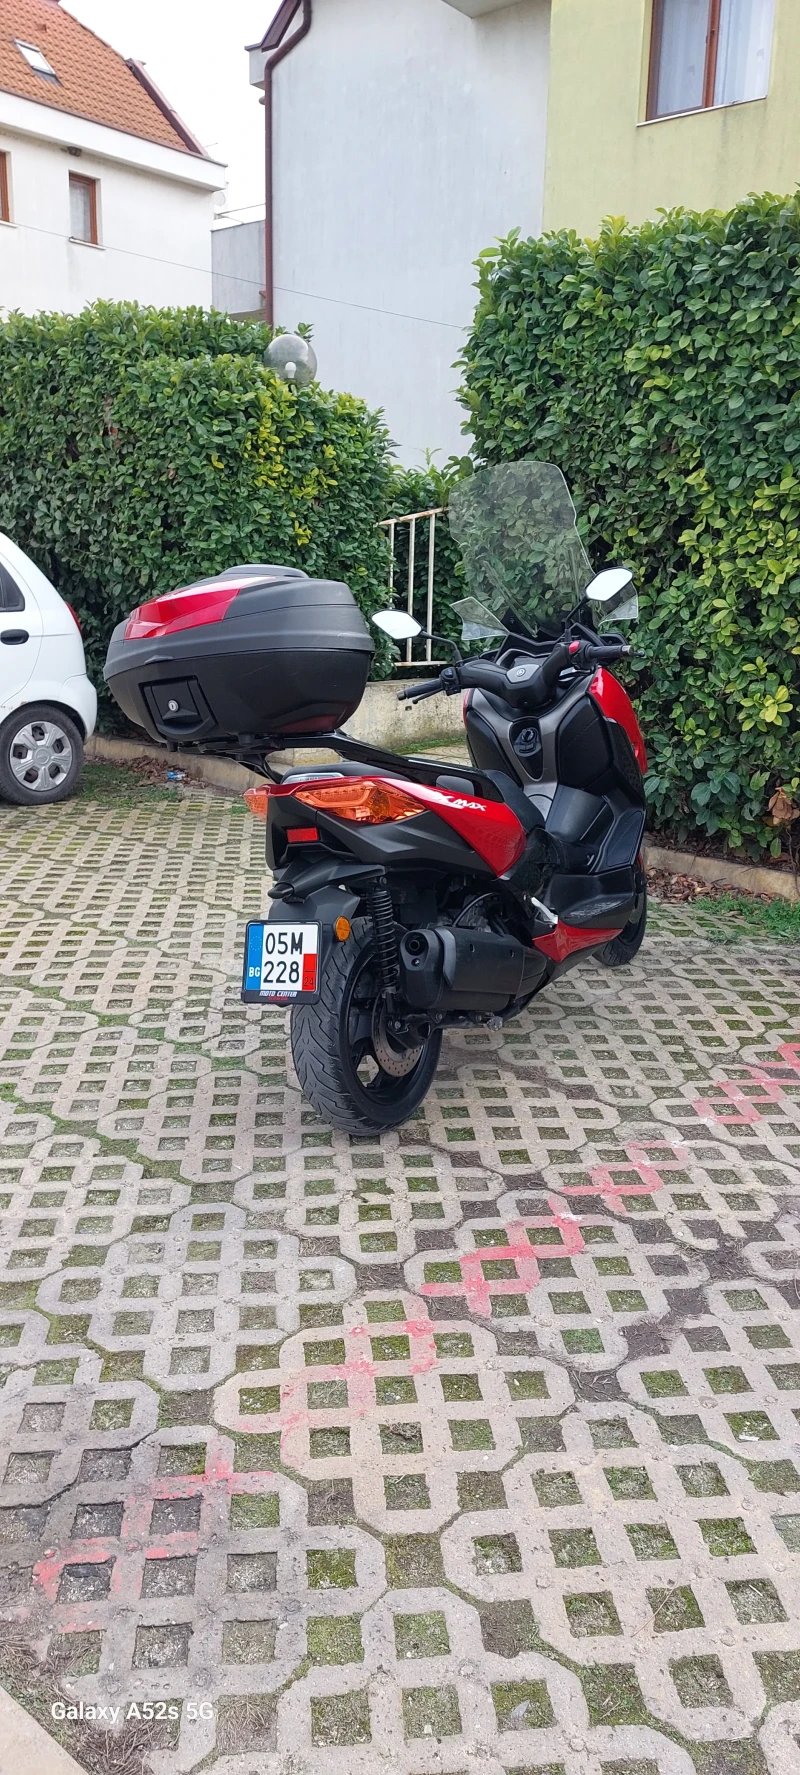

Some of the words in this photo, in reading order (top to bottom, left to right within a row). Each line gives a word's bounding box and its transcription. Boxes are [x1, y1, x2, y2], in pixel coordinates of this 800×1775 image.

[265, 932, 303, 955] 05M
[249, 967, 260, 977] BG
[263, 961, 300, 984] 228
